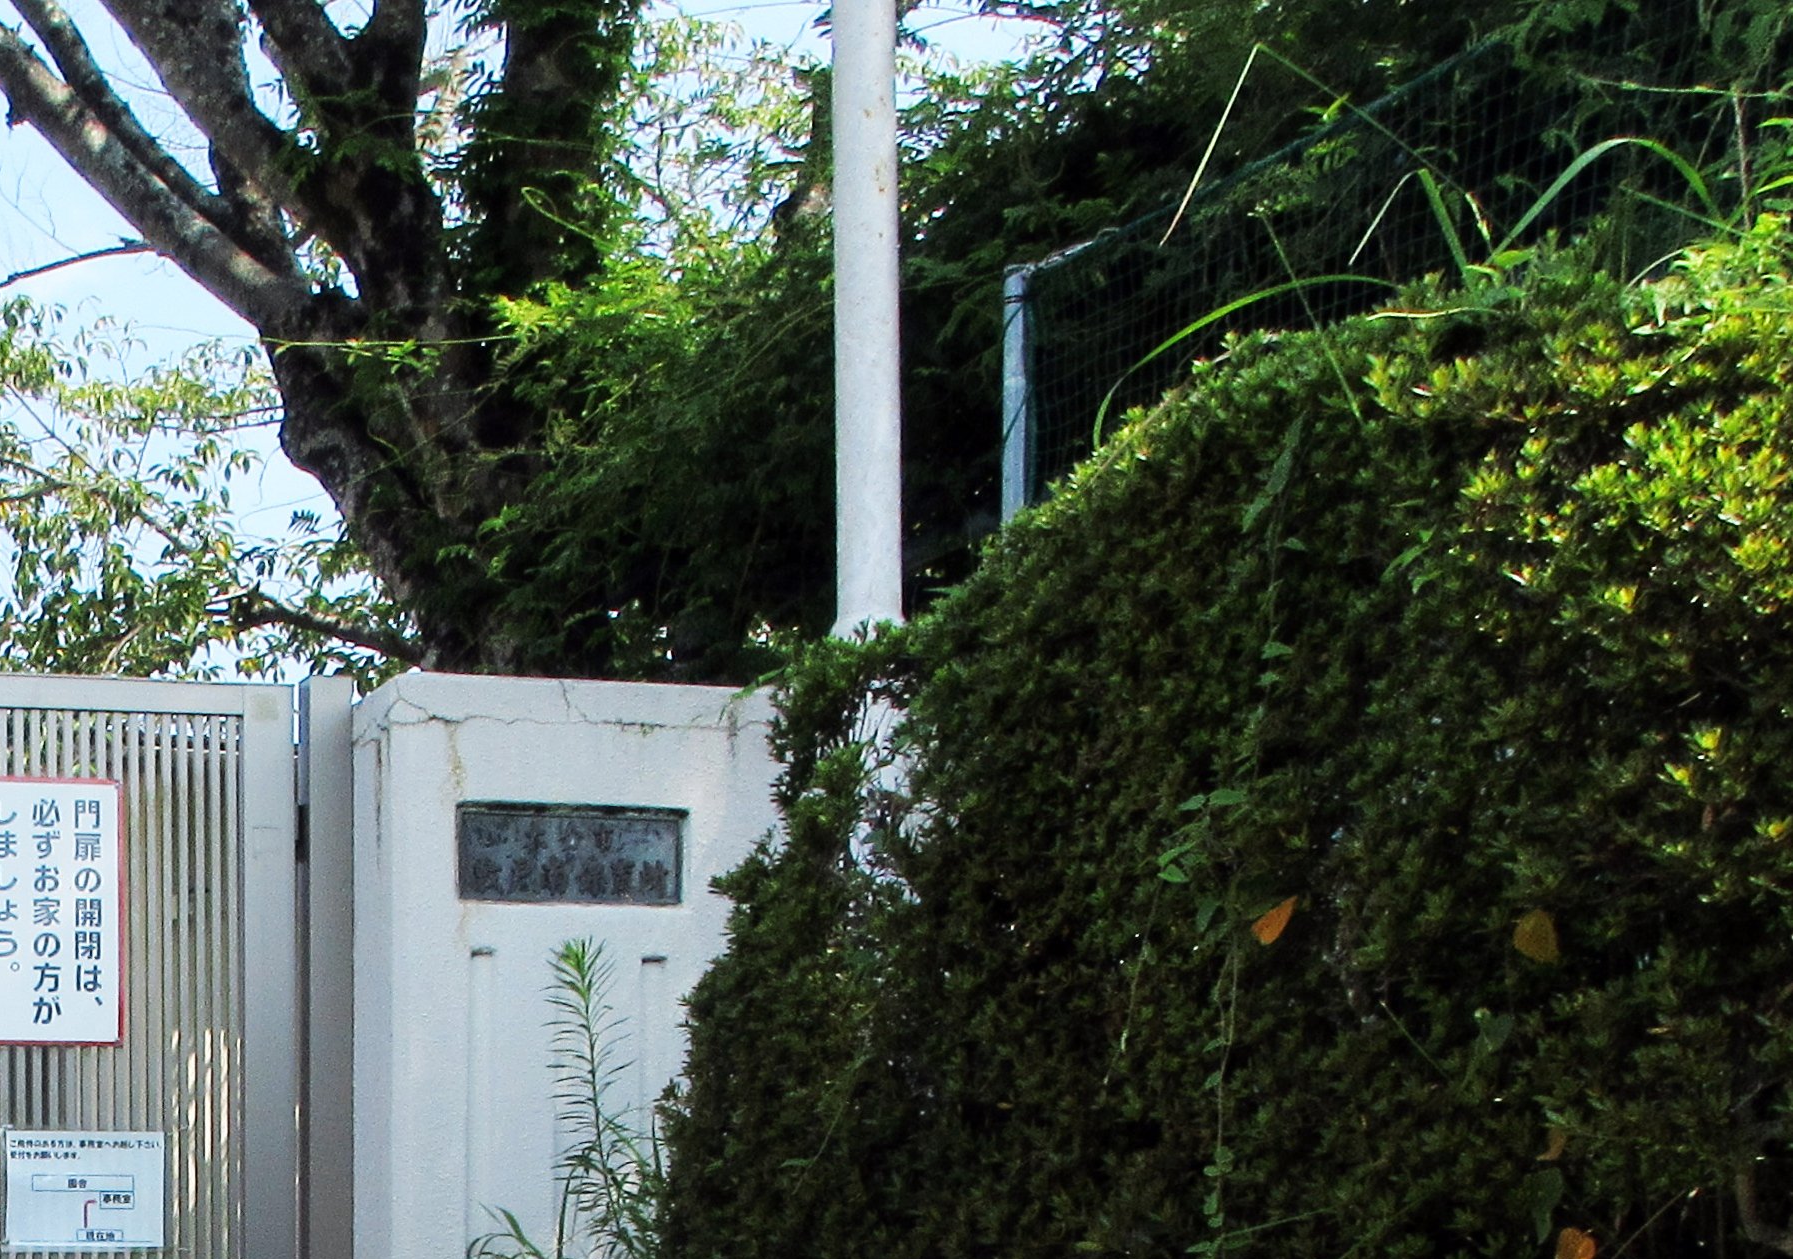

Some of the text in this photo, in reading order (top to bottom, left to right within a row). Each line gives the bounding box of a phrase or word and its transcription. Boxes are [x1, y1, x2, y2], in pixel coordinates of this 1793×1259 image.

[32, 798, 62, 1025] 必ずお家の方が
[74, 799, 103, 1006] 門扉の開閉は、
